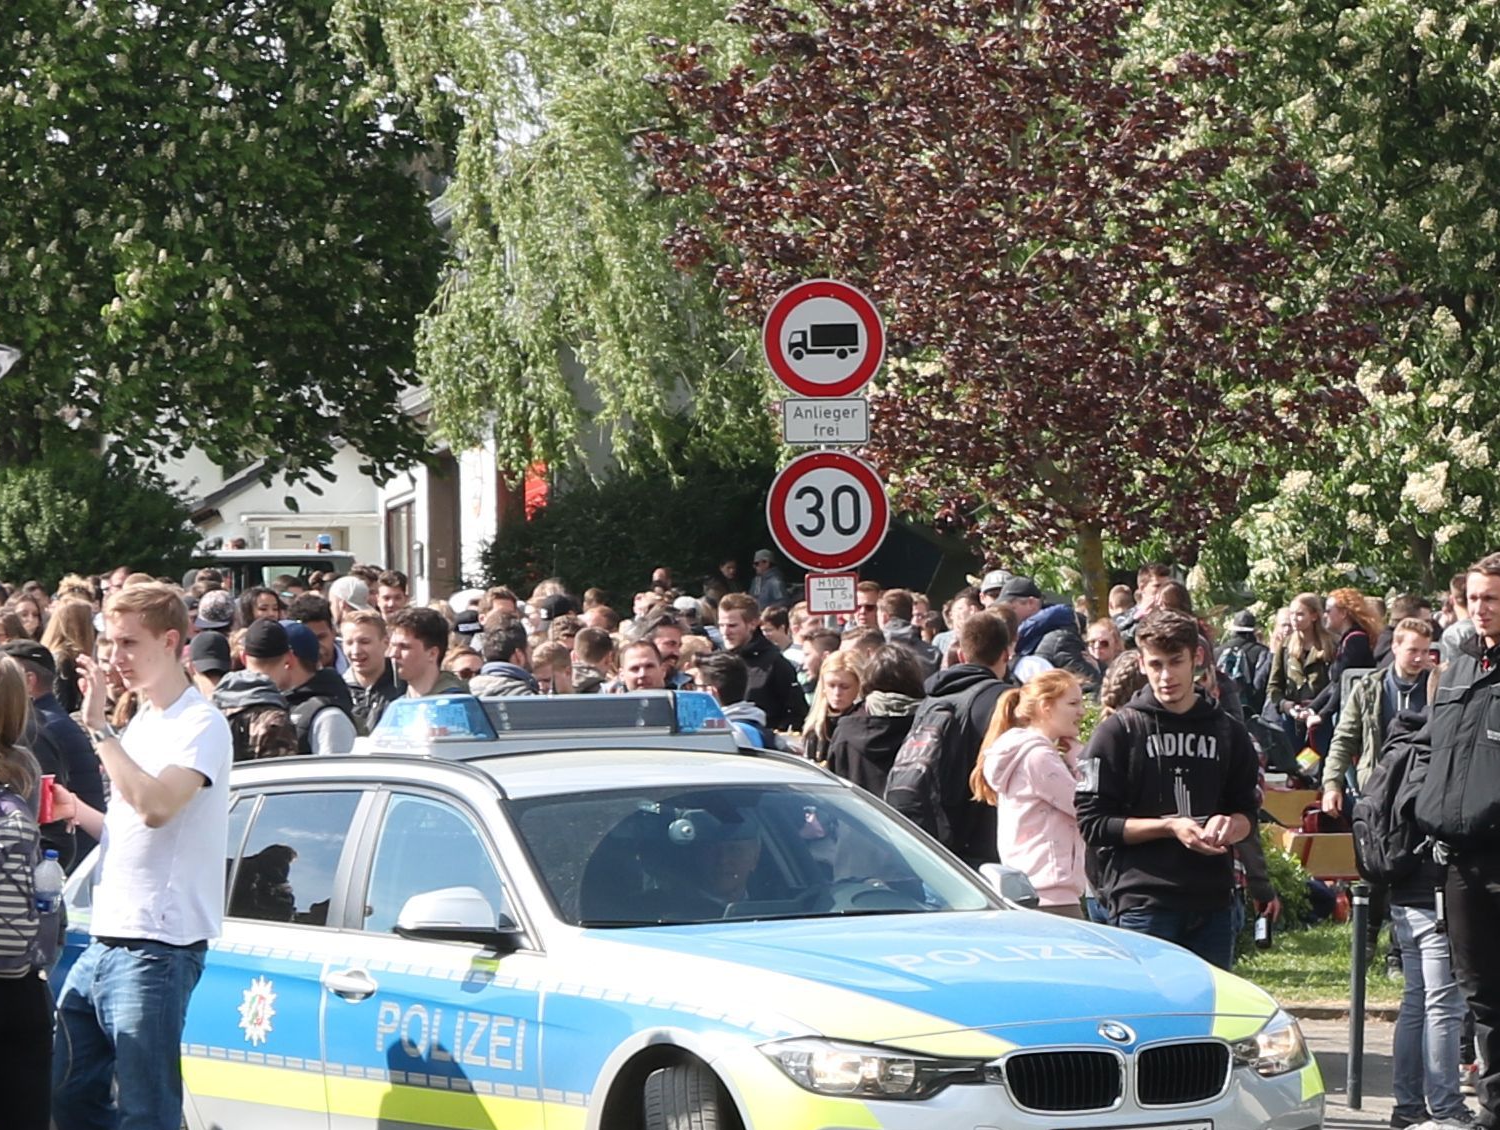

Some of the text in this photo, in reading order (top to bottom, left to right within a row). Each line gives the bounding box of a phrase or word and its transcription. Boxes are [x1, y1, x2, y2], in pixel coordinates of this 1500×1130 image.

[793, 406, 858, 422] Anlieger
[813, 423, 840, 436] frei
[794, 484, 861, 537] 30
[879, 944, 1135, 972] POLIZEI
[375, 1001, 528, 1072] POLIZEI
